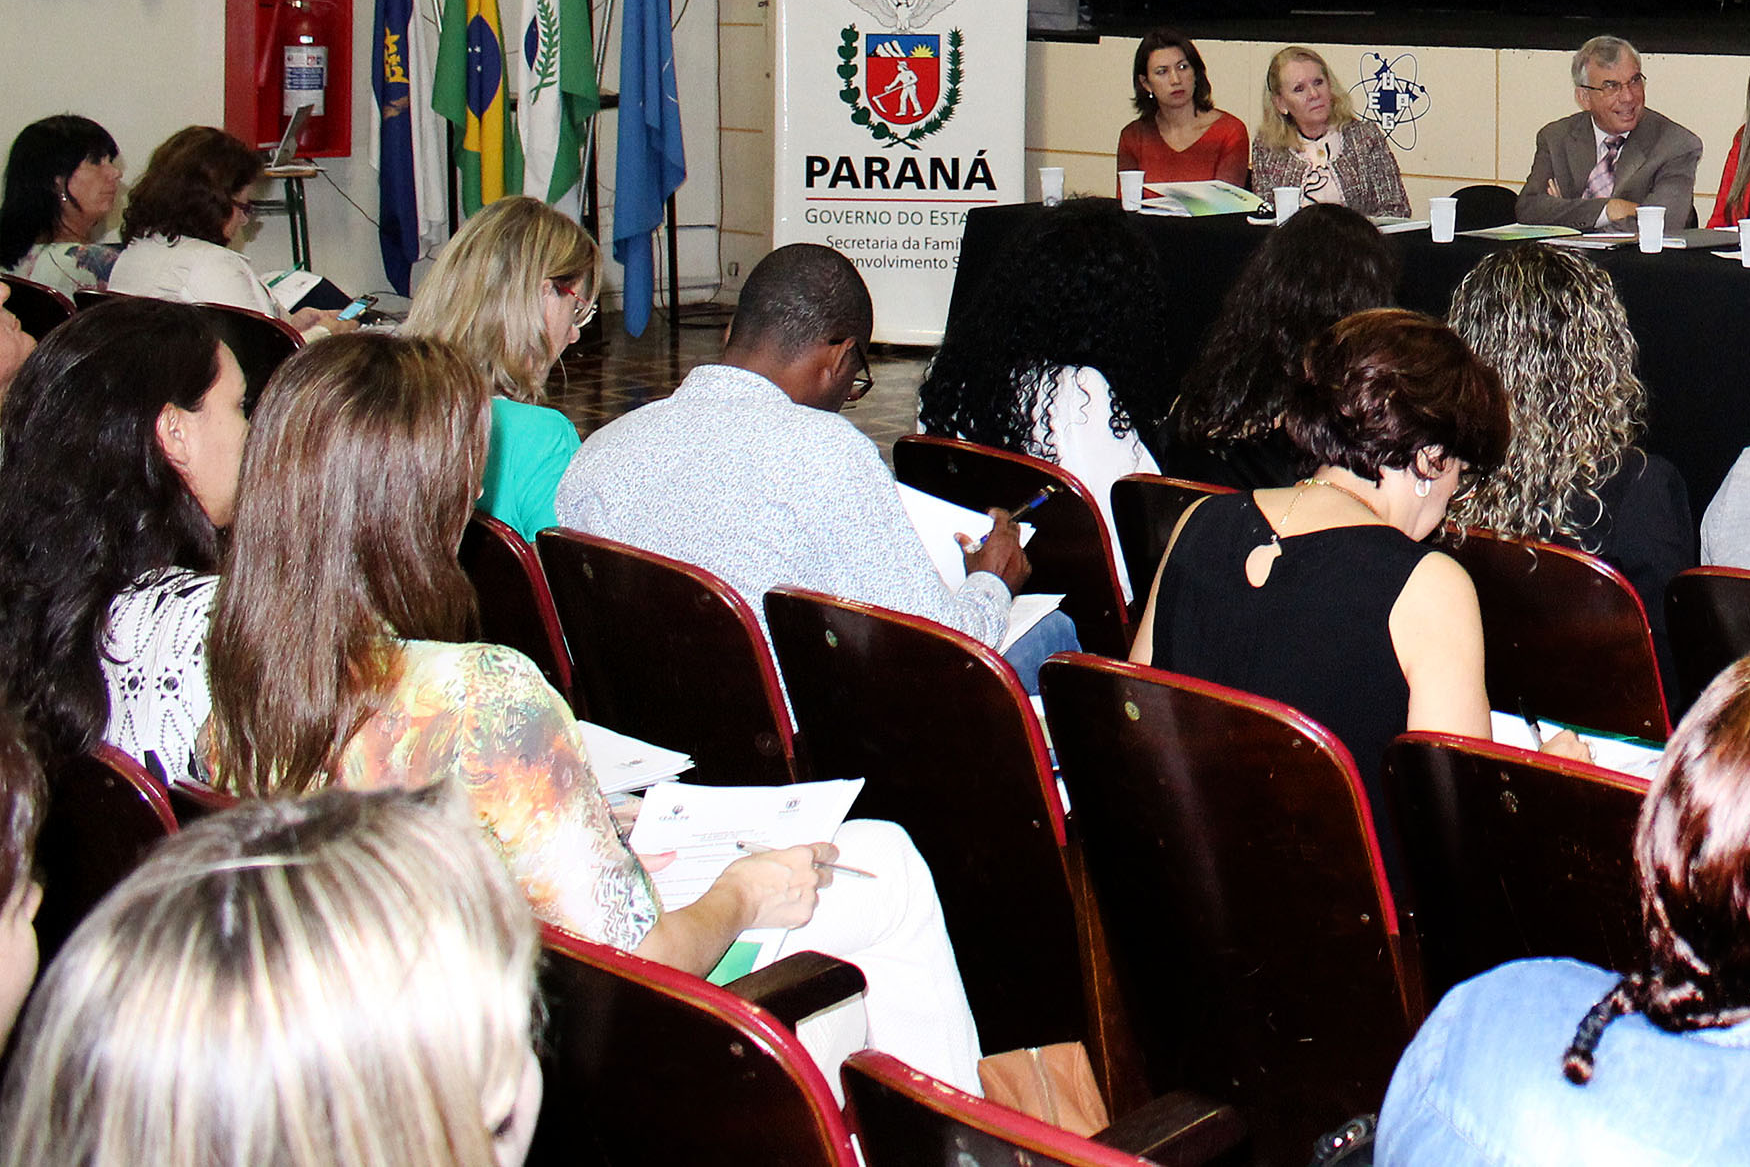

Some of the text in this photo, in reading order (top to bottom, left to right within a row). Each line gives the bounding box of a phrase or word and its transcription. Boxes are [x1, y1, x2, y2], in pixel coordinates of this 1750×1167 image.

[804, 149, 998, 191] PARANÁ
[804, 208, 969, 226] GOVERNO DO ESTA
[826, 235, 962, 251] Secretaria da Famíl
